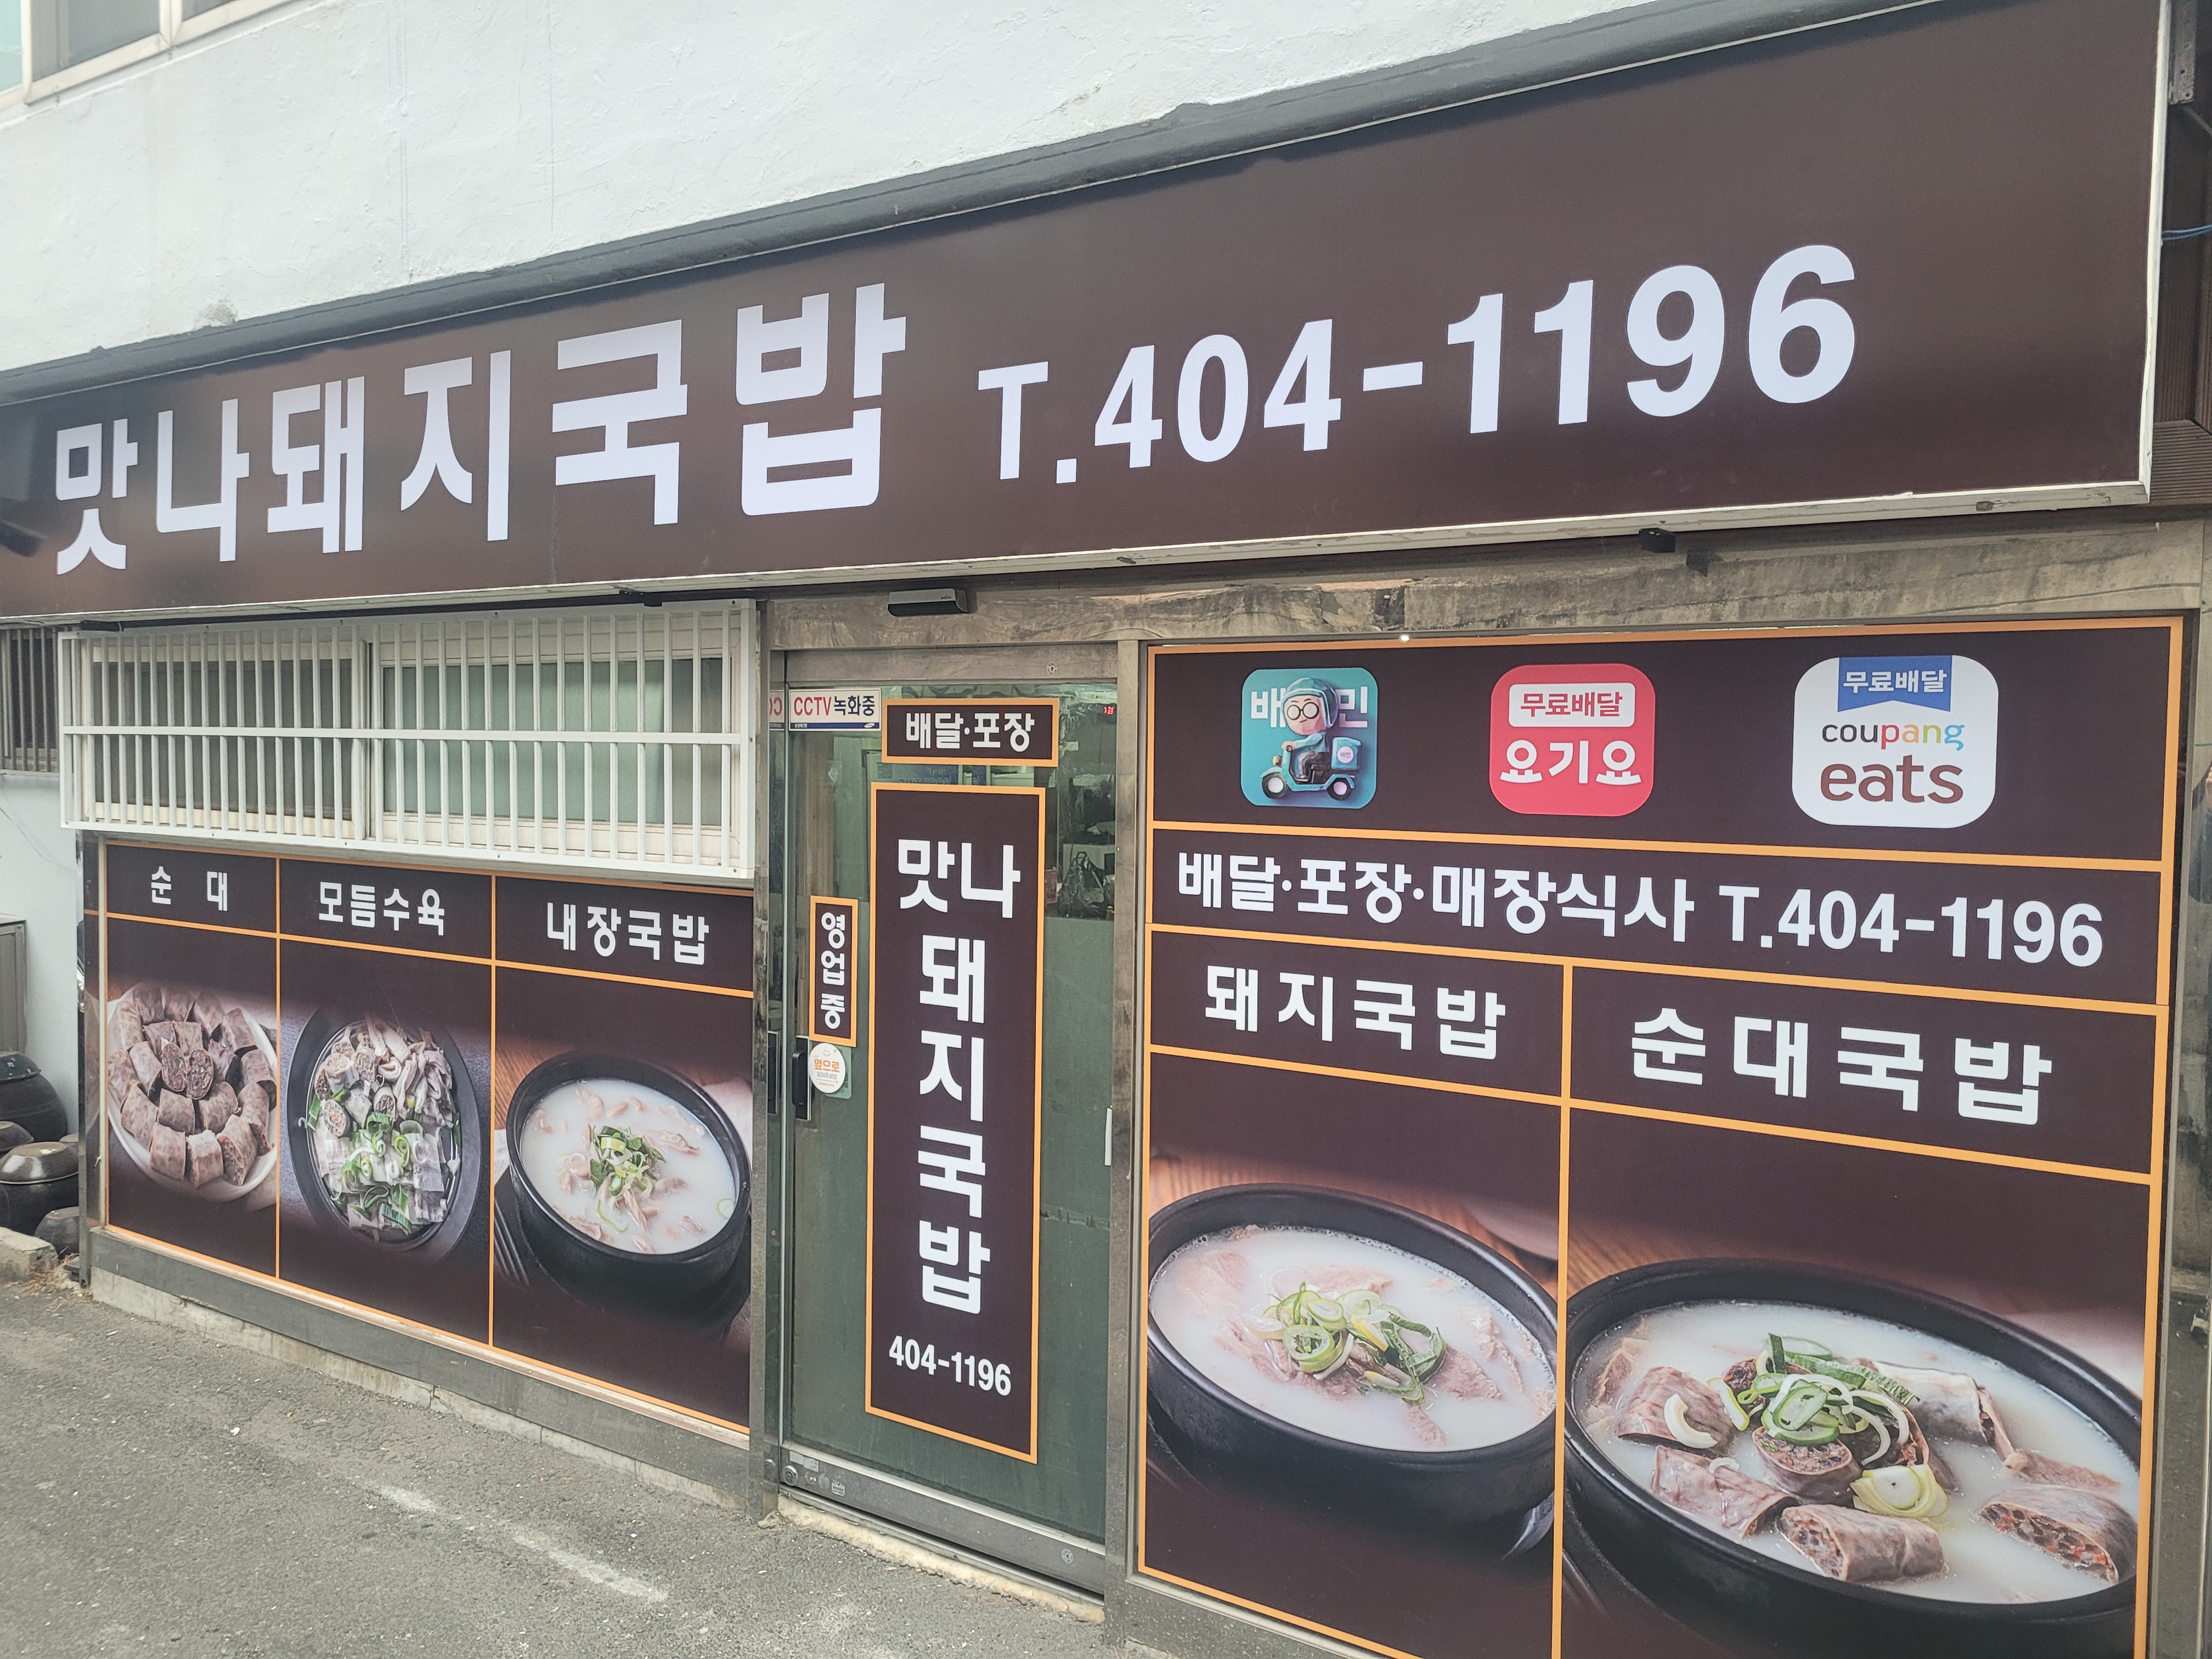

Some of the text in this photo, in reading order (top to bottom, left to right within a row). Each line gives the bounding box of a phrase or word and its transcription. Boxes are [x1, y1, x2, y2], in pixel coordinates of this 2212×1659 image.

[56, 283, 906, 575] 맛나돼지국밥
[1521, 692, 1623, 717] 무료배달
[1843, 669, 1947, 693] 무료배달
[1499, 739, 1641, 786] 요기요
[1822, 724, 1965, 752] coupang
[1821, 755, 1963, 804] eats
[319, 881, 445, 936] 모듬수육
[547, 902, 709, 966] 내장국밥
[1719, 885, 2103, 968] T.404-1196
[1205, 964, 1506, 1060] 돼지국밥
[1631, 1007, 2053, 1126] 순대국밥
[889, 1335, 1012, 1397] 404-1196
